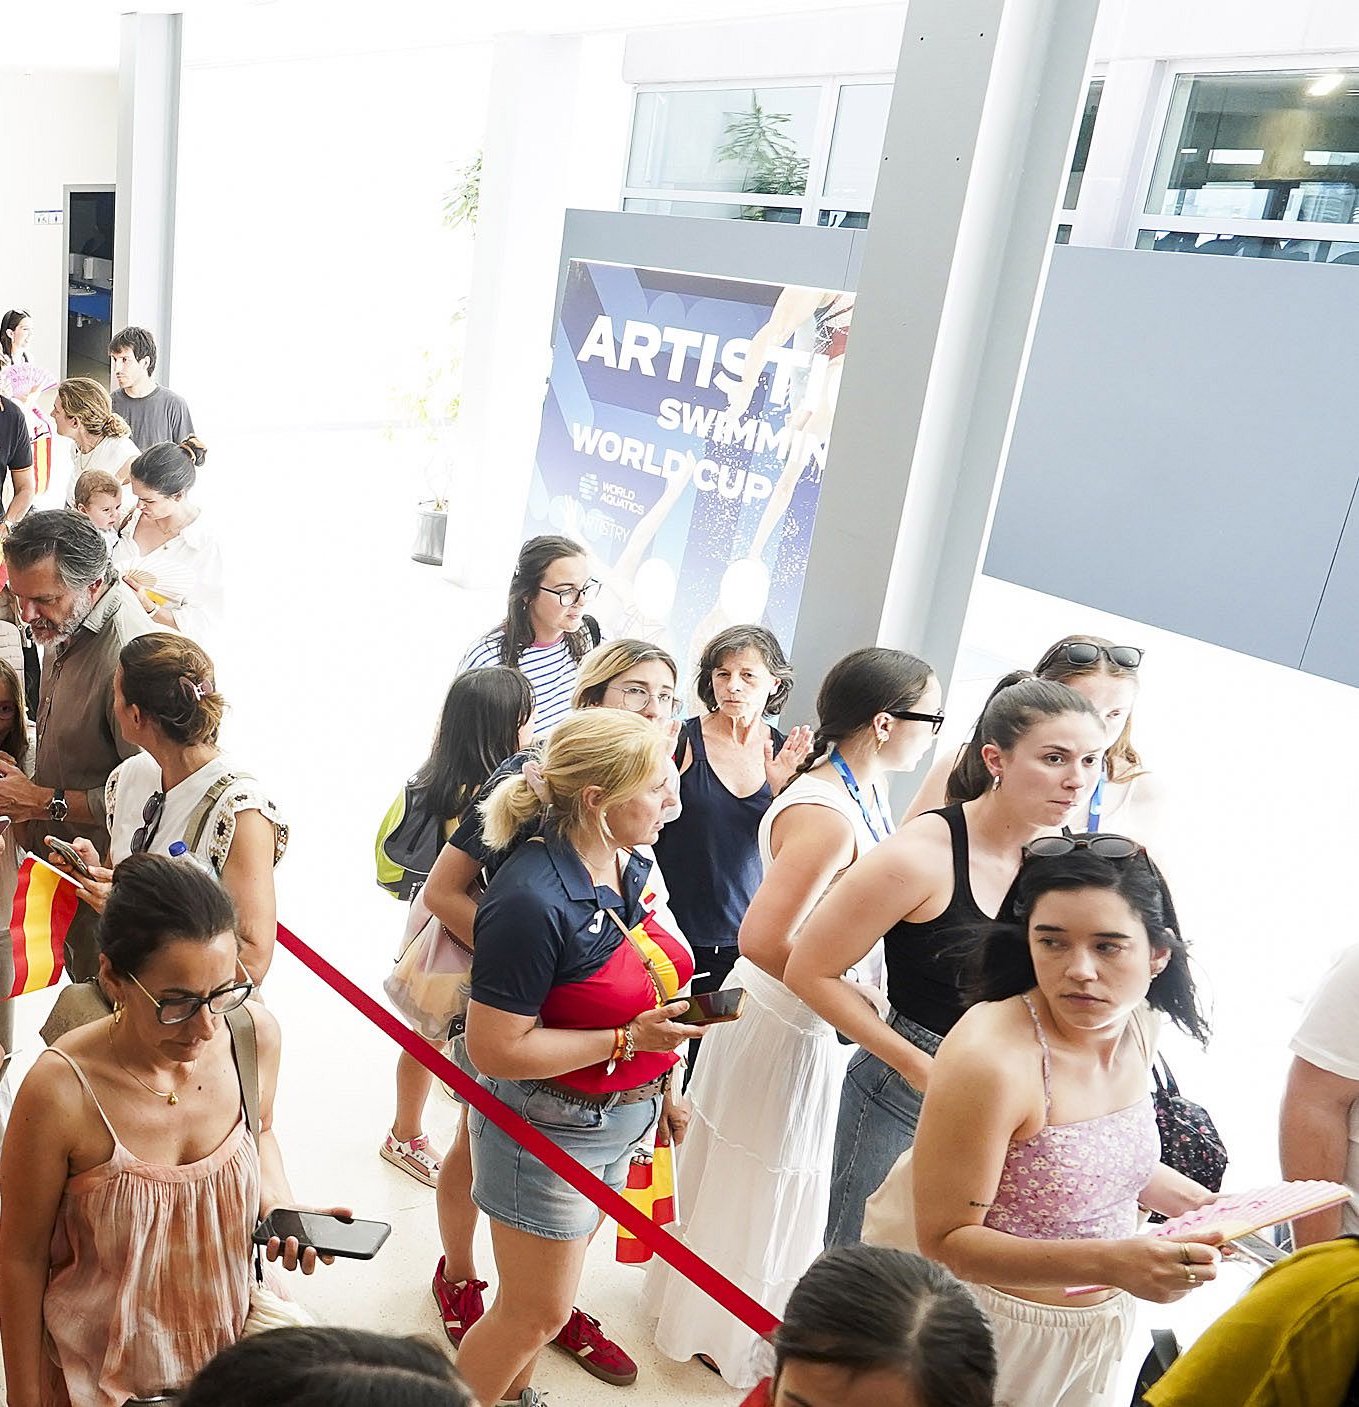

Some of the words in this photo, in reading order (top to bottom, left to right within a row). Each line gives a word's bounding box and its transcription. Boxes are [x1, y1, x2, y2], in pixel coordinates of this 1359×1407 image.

[576, 314, 830, 412] ARTISTI
[572, 422, 689, 481] WORLD
[693, 459, 773, 504] CUP
[656, 398, 826, 472] SWIMMIN
[600, 494, 645, 516] AQUATICS
[602, 481, 635, 501] WORLD
